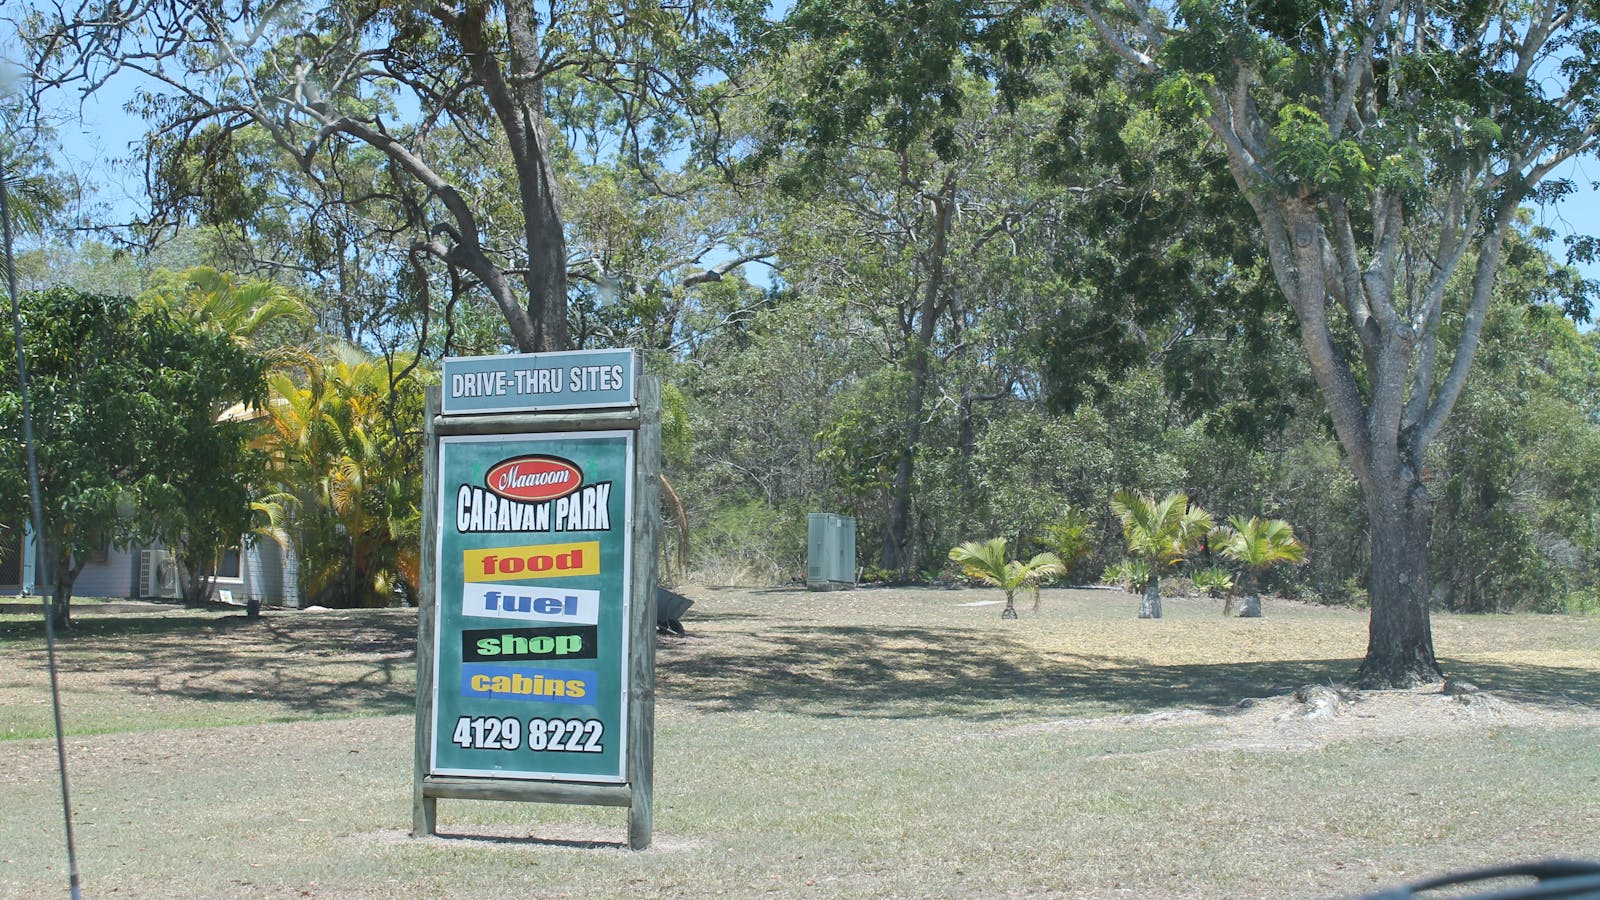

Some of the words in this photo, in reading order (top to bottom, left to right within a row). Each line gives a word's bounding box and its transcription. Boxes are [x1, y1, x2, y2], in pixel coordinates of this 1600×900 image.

[452, 367, 563, 398] DRIVE-THRU
[569, 365, 624, 392] SITES
[498, 466, 571, 491] Maaroom
[457, 483, 550, 533] CARAVAN
[555, 481, 612, 532] PARK
[481, 549, 583, 575] food
[483, 591, 578, 616] fuel
[476, 634, 583, 656] shop
[470, 673, 586, 698] cabins
[452, 716, 521, 750] 4129
[528, 718, 604, 753] 8222
